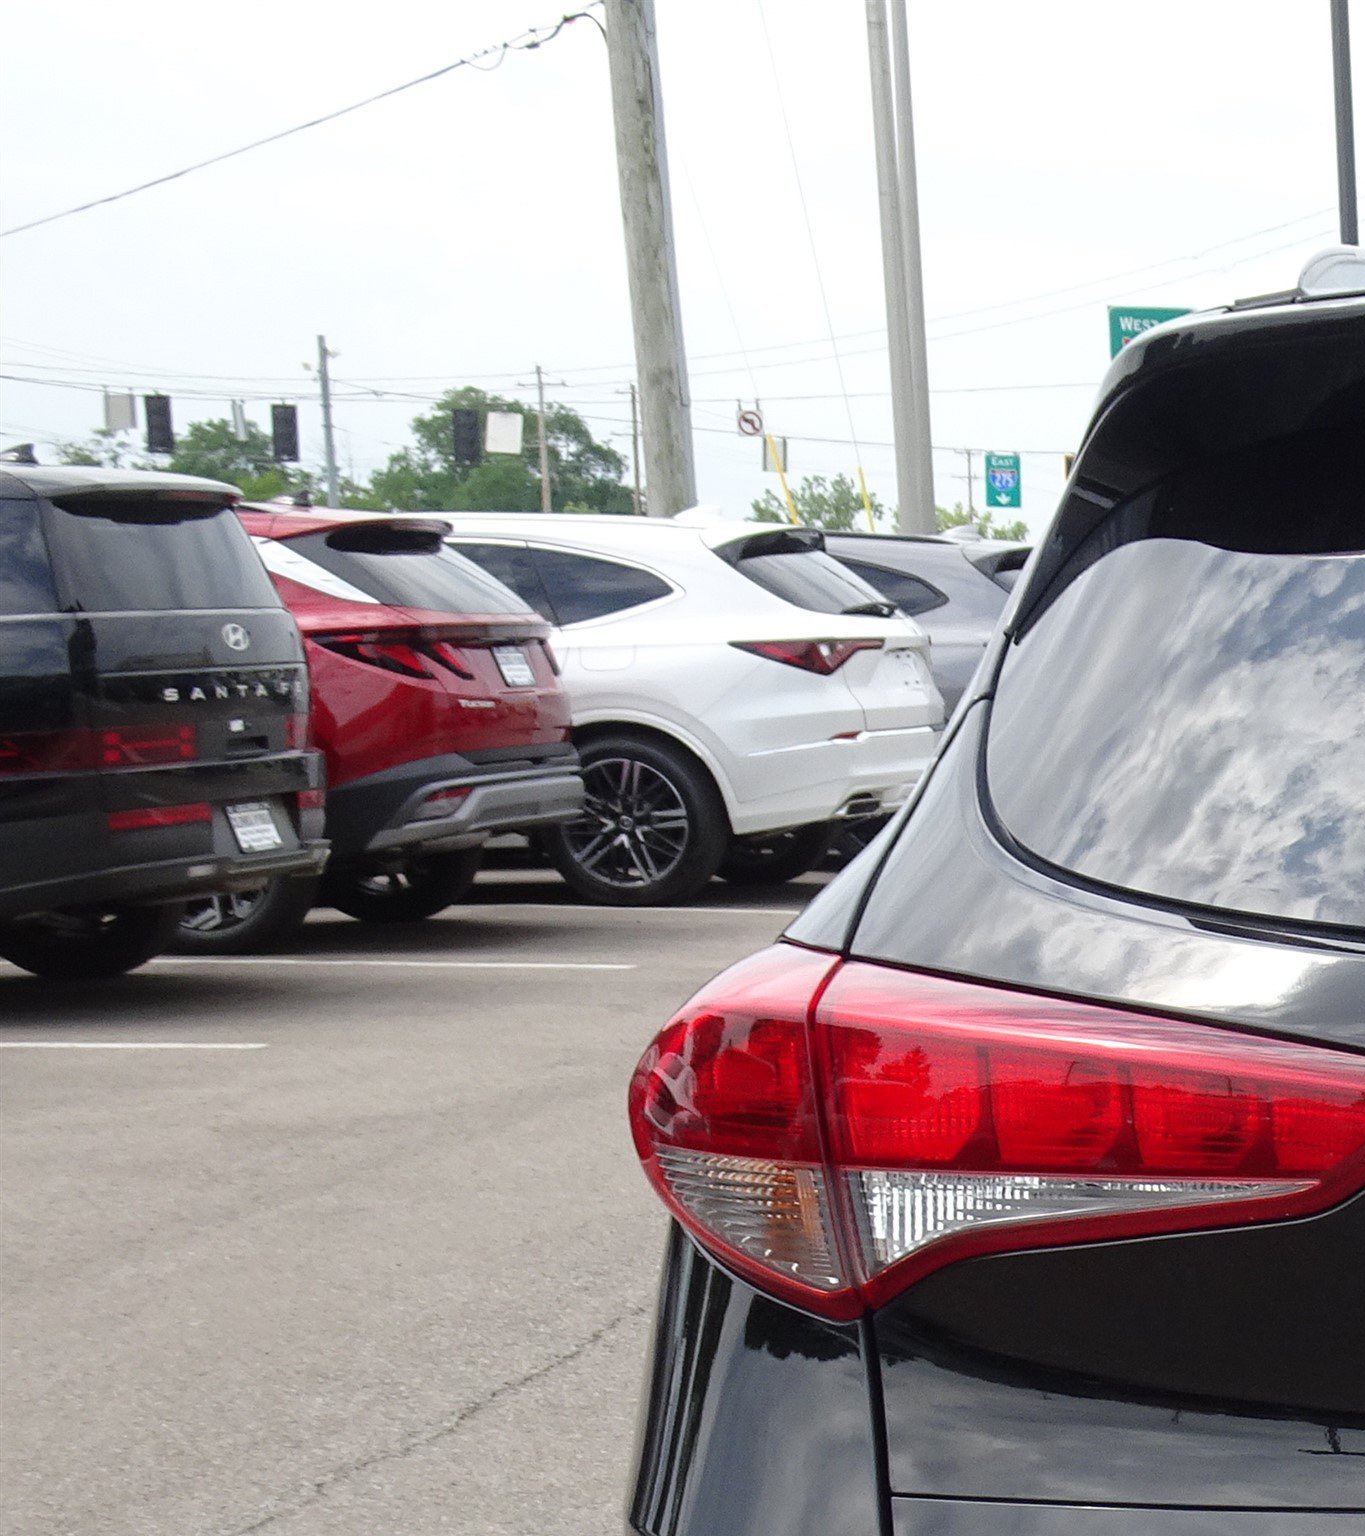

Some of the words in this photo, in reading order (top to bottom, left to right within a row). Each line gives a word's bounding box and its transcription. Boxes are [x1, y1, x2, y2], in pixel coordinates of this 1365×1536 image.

[991, 456, 1014, 466] EAST
[994, 473, 1015, 488] 275
[163, 682, 269, 701] SANTA
